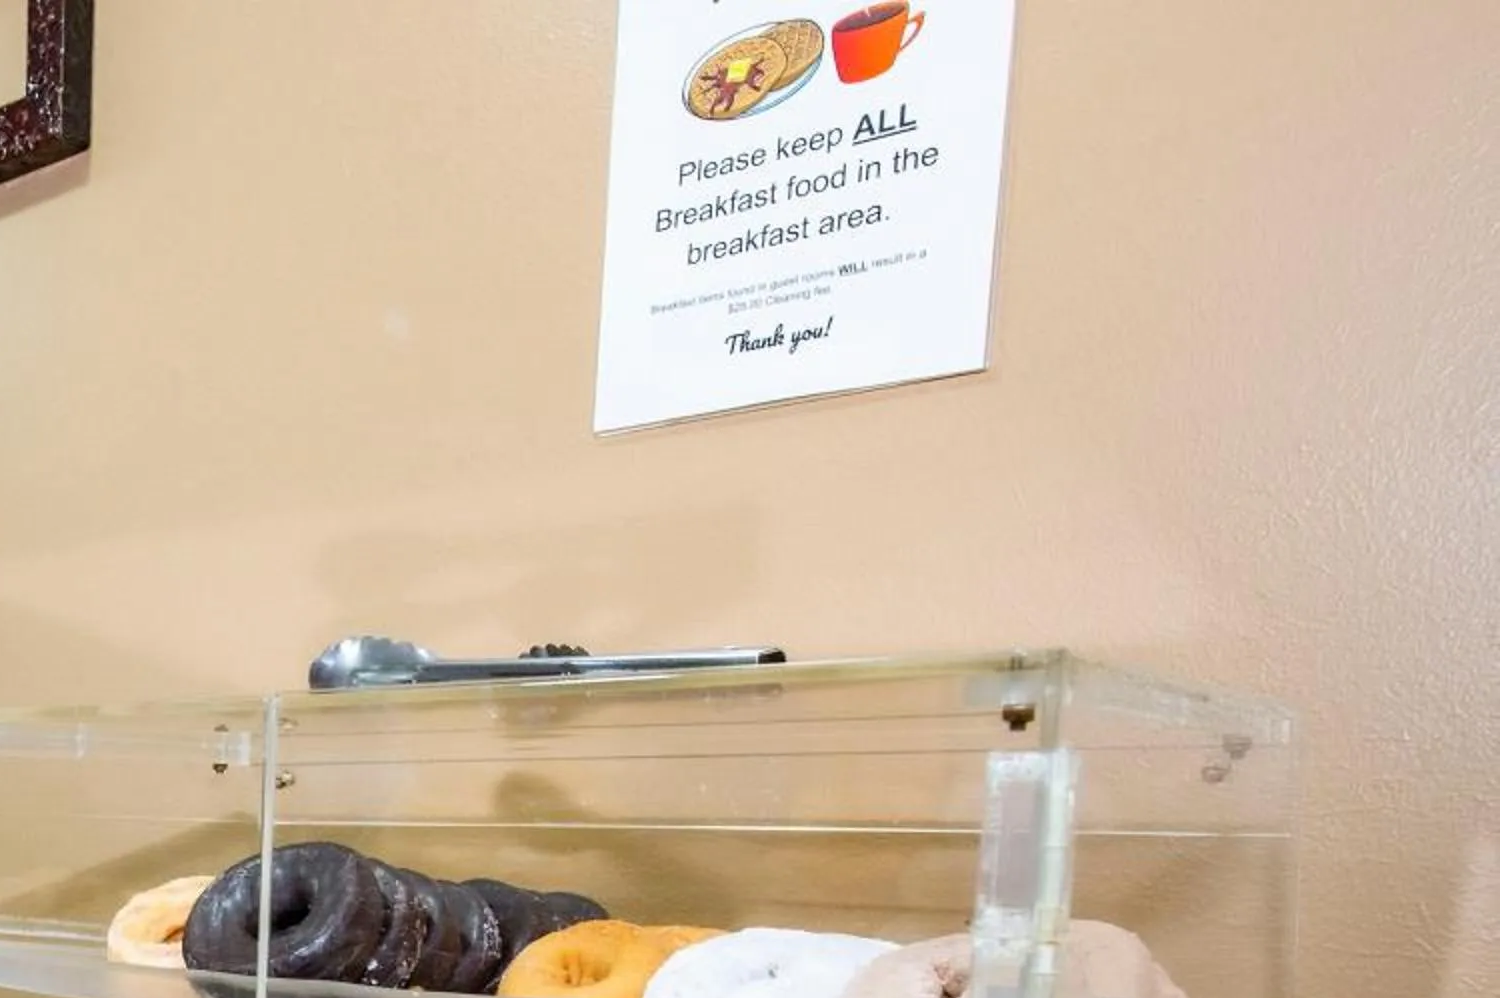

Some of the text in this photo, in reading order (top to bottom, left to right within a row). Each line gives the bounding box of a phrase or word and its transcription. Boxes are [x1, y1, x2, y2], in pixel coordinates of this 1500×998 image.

[678, 103, 918, 187] Please keep ALL
[655, 146, 940, 233] Breakfast food in the
[686, 204, 891, 265] breakfast area.
[837, 260, 868, 276] WILL
[723, 315, 834, 356] Thank you!
